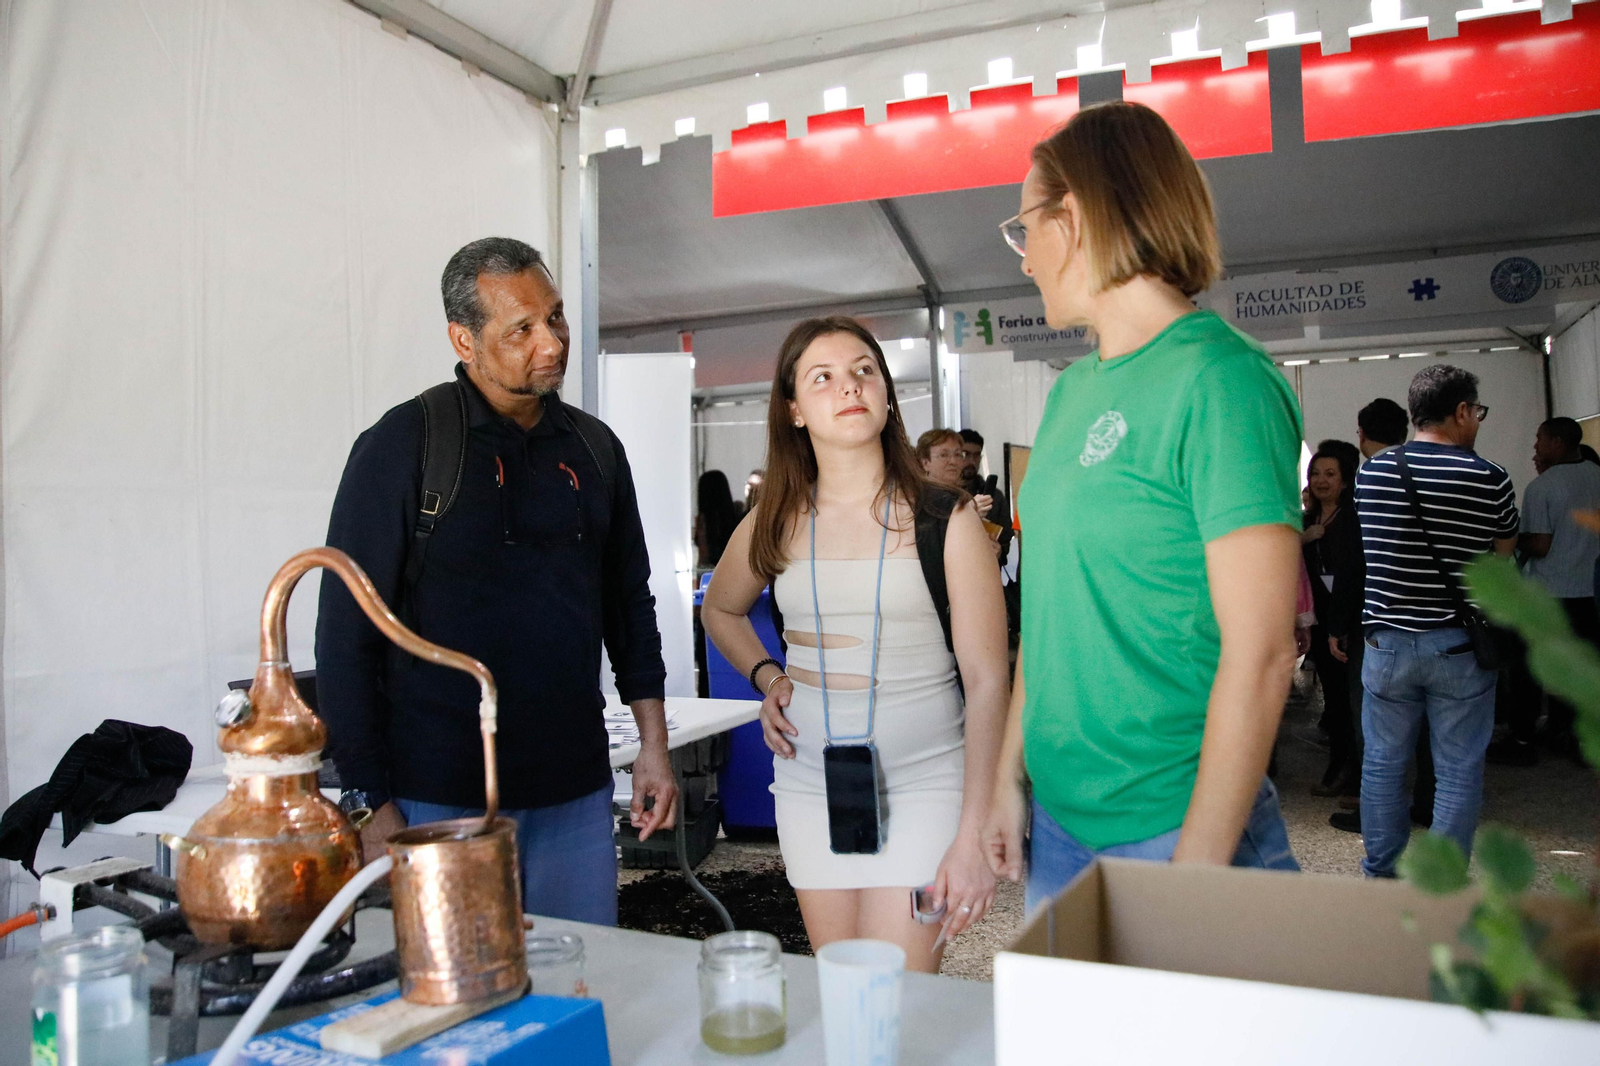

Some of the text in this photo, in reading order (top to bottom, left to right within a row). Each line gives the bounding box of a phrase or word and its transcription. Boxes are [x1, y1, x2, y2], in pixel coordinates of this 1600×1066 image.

[1544, 277, 1565, 290] DE
[1236, 281, 1365, 304] FACULTAD DE
[1236, 296, 1366, 318] HUMANIDADES
[998, 314, 1033, 329] Feria
[1001, 328, 1087, 344] Construye tu fu
